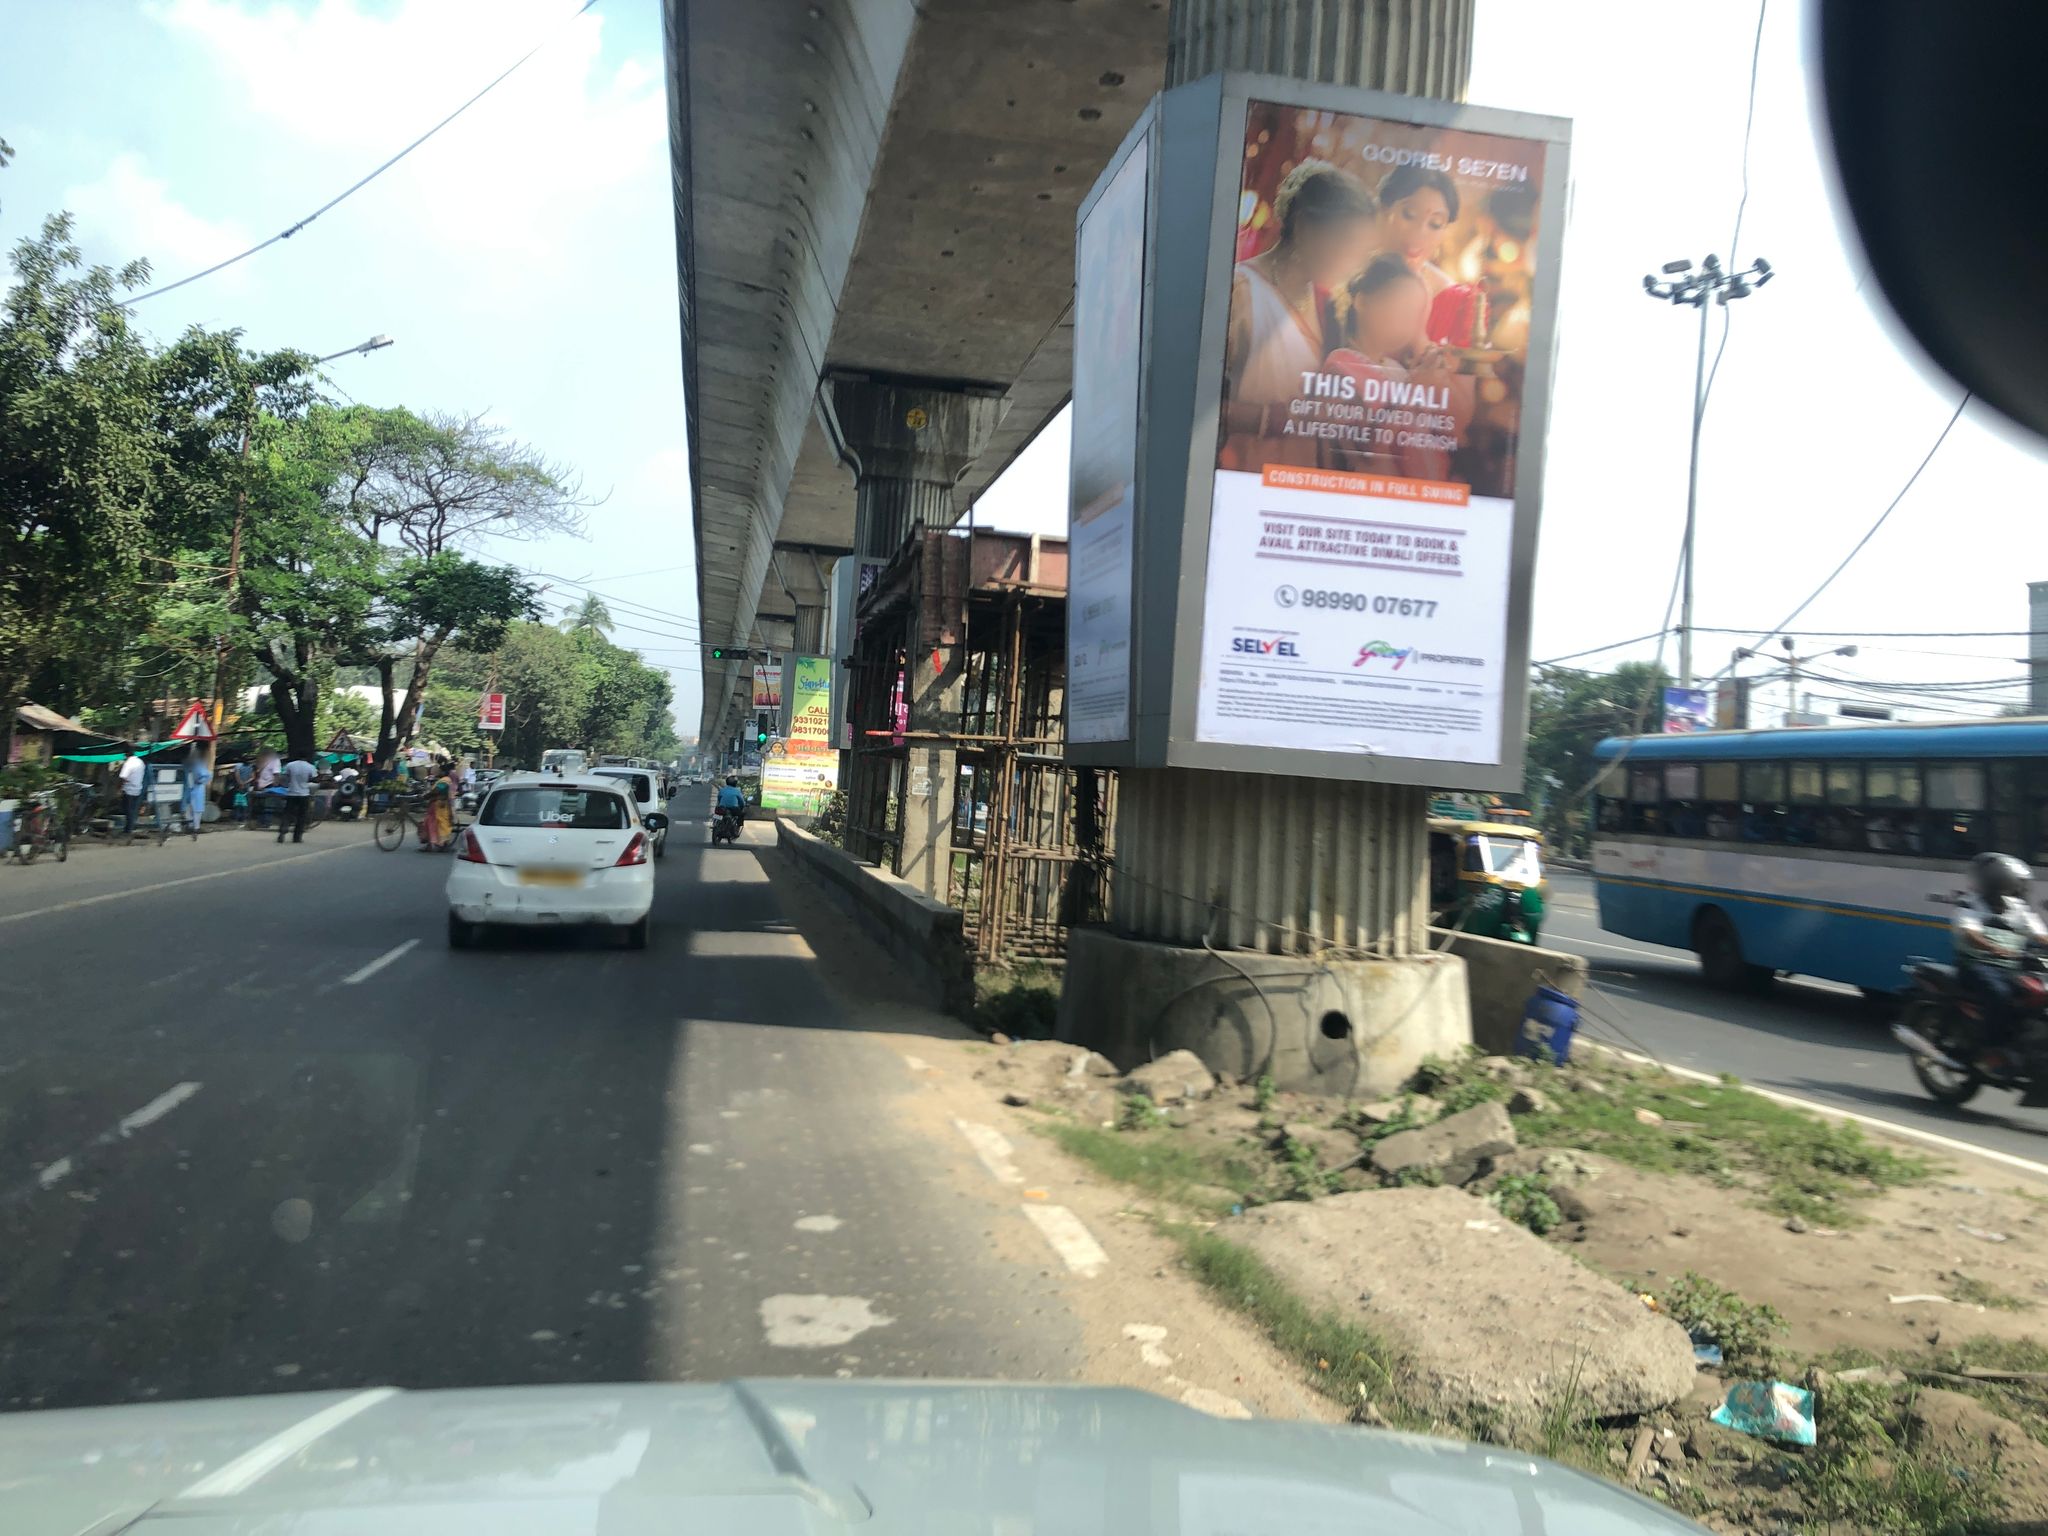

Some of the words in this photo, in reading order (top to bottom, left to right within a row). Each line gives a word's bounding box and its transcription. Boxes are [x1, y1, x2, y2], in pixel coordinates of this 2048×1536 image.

[1362, 143, 1452, 172] GODREJ
[1457, 156, 1528, 182] SE7EN
[1301, 371, 1356, 399] THIS
[1364, 378, 1450, 410] DIWALI
[1290, 398, 1323, 417] GIFT
[1326, 402, 1364, 420] YOUR
[1366, 407, 1414, 426] LOVED
[1416, 412, 1455, 431] ONES
[1283, 418, 1295, 434] A
[1297, 420, 1371, 443] LIFESTYLE
[1374, 428, 1394, 444] TO
[1396, 430, 1458, 452] CHERISH
[1269, 469, 1368, 492] CONSTRUCTION
[1370, 480, 1384, 494] IN
[1387, 481, 1417, 498] FULL
[1421, 484, 1463, 502] SWING
[1259, 535, 1293, 550] AVAIL
[1297, 539, 1369, 558] ATTRACTIVE
[1371, 546, 1413, 562] DIWALI
[1415, 550, 1461, 567] OFFERS
[1263, 521, 1294, 536] VISIT
[1298, 525, 1323, 539] OUR
[1325, 527, 1352, 542] SITE
[1355, 530, 1392, 545] TODAY
[1396, 534, 1411, 547] TO
[1414, 536, 1446, 551] BOOK
[1302, 588, 1367, 613] 98990
[1373, 595, 1438, 618] 07677
[1232, 636, 1300, 657] SELVEL
[794, 715, 829, 726] 9331021
[808, 706, 829, 715] CALL
[792, 725, 829, 736] 9831700
[539, 811, 575, 822] Uber
